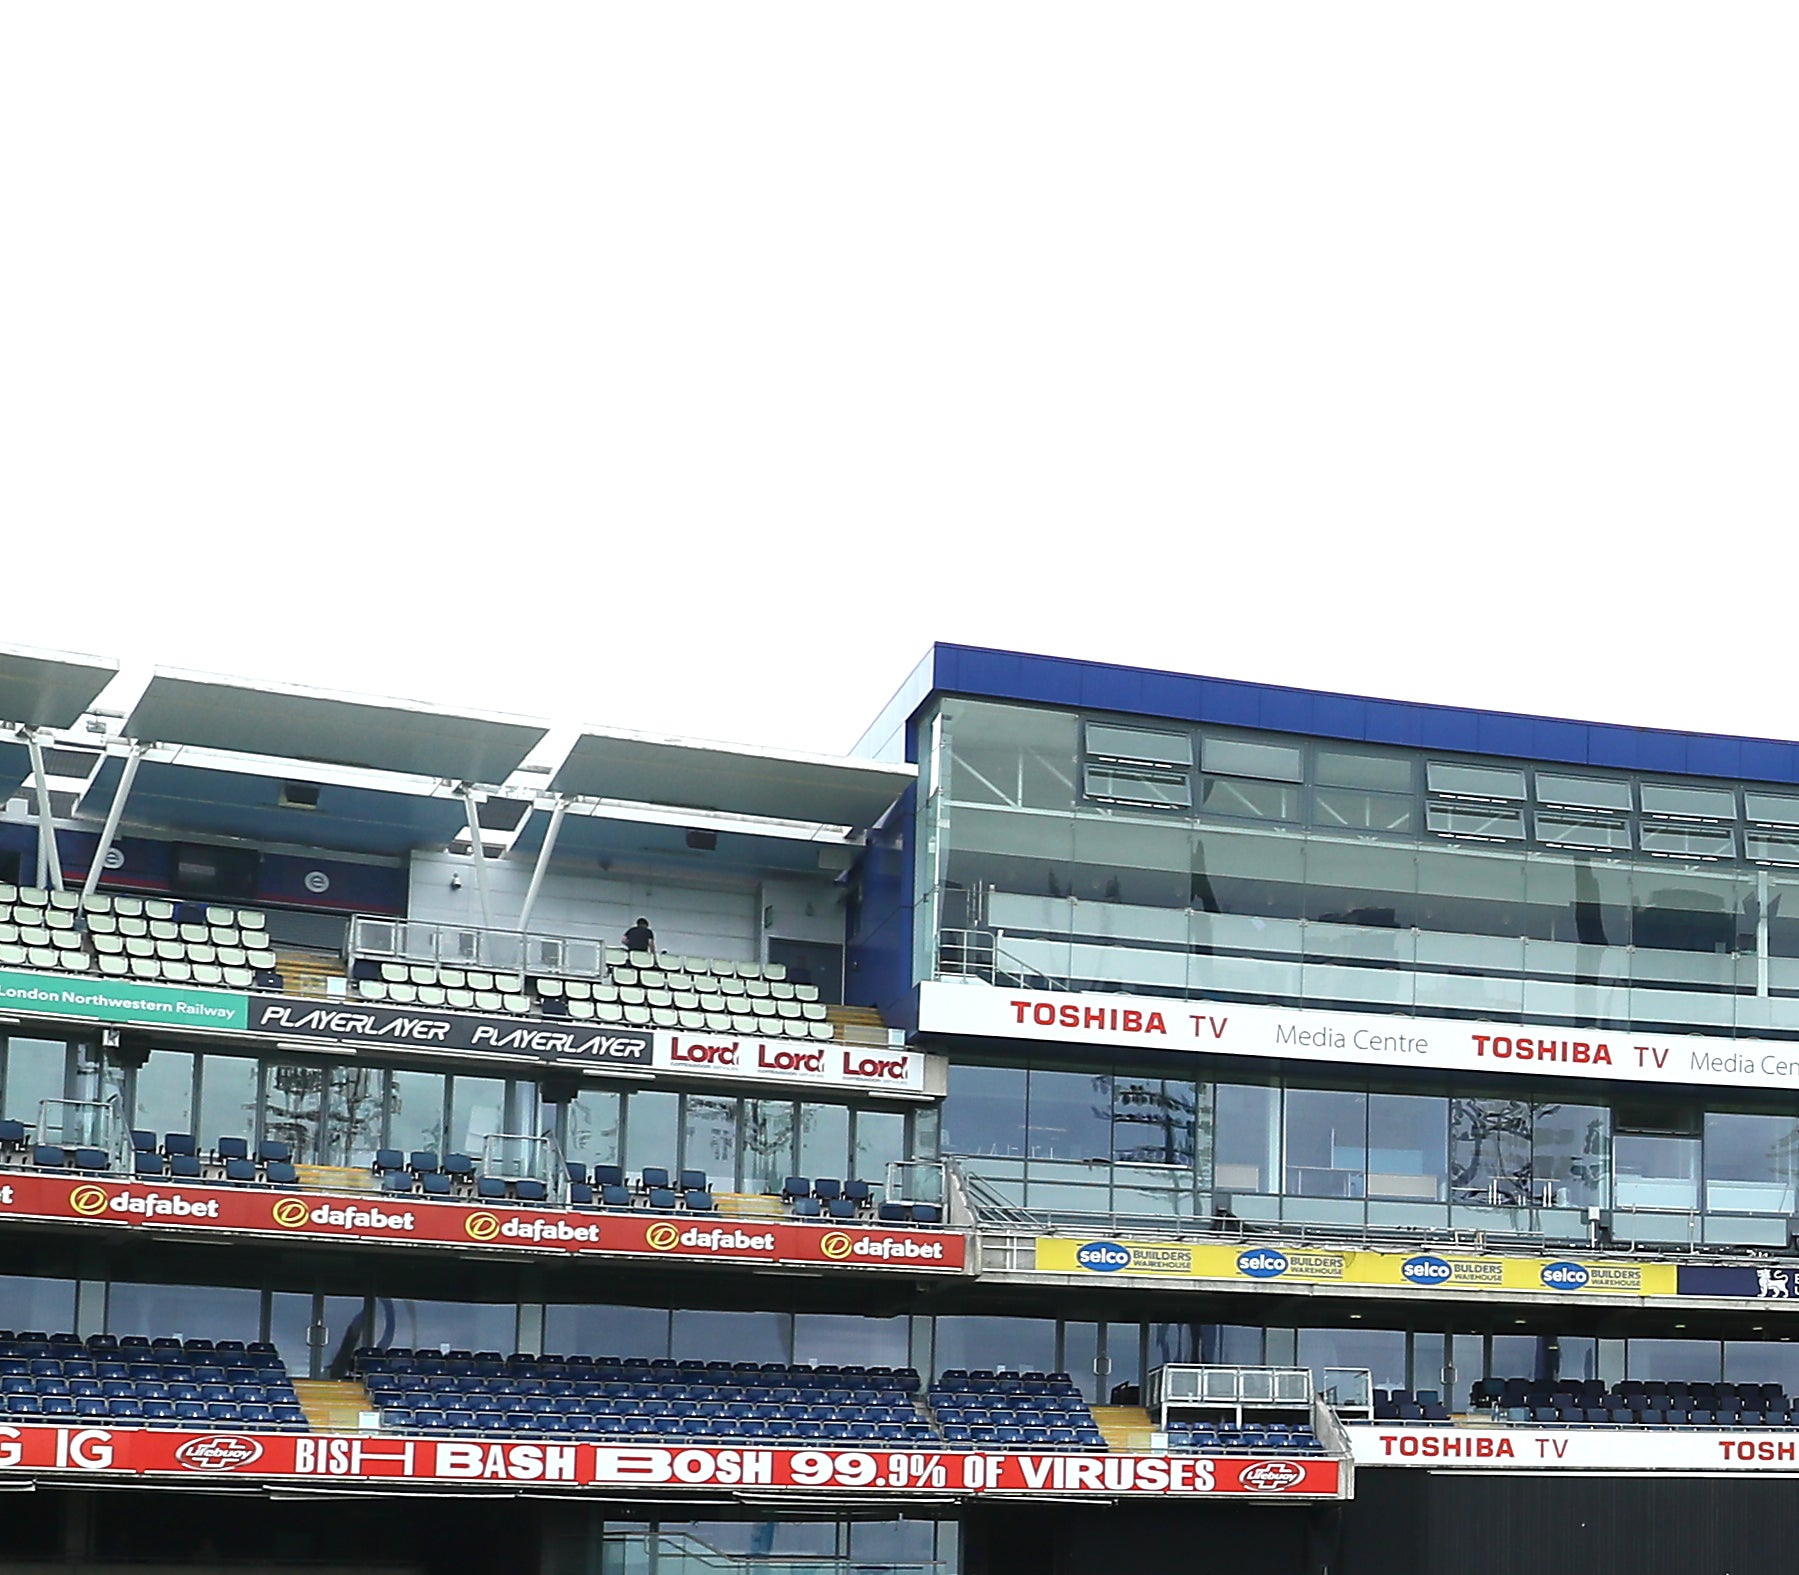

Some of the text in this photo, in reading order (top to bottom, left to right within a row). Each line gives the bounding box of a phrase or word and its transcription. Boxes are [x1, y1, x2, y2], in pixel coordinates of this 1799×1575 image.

[0, 984, 236, 1021] London Northwestern Railway
[260, 1006, 452, 1041] PLAYERLAYER
[1010, 1000, 1429, 1055] TOSHIBA TV Media Centre
[471, 1025, 647, 1058] PLAYERLAYER
[1472, 1034, 1613, 1066] TOSHIBA
[1634, 1046, 1670, 1069] TV
[1691, 1051, 1755, 1075] Media
[110, 1192, 219, 1219] dafabet
[311, 1204, 415, 1231] dafabet
[501, 1217, 600, 1243] dafabet
[680, 1227, 775, 1253] dafabet
[853, 1236, 943, 1261] dafabet
[1080, 1248, 1128, 1264] selco
[1240, 1254, 1286, 1270] selco
[1404, 1262, 1450, 1277] selco
[1543, 1268, 1588, 1284] selco
[56, 1429, 114, 1469] IG
[1380, 1435, 1569, 1459] TOSHIBA TV
[295, 1438, 1216, 1492] BISH BASH BOSH 99.9% OF VIRUSES
